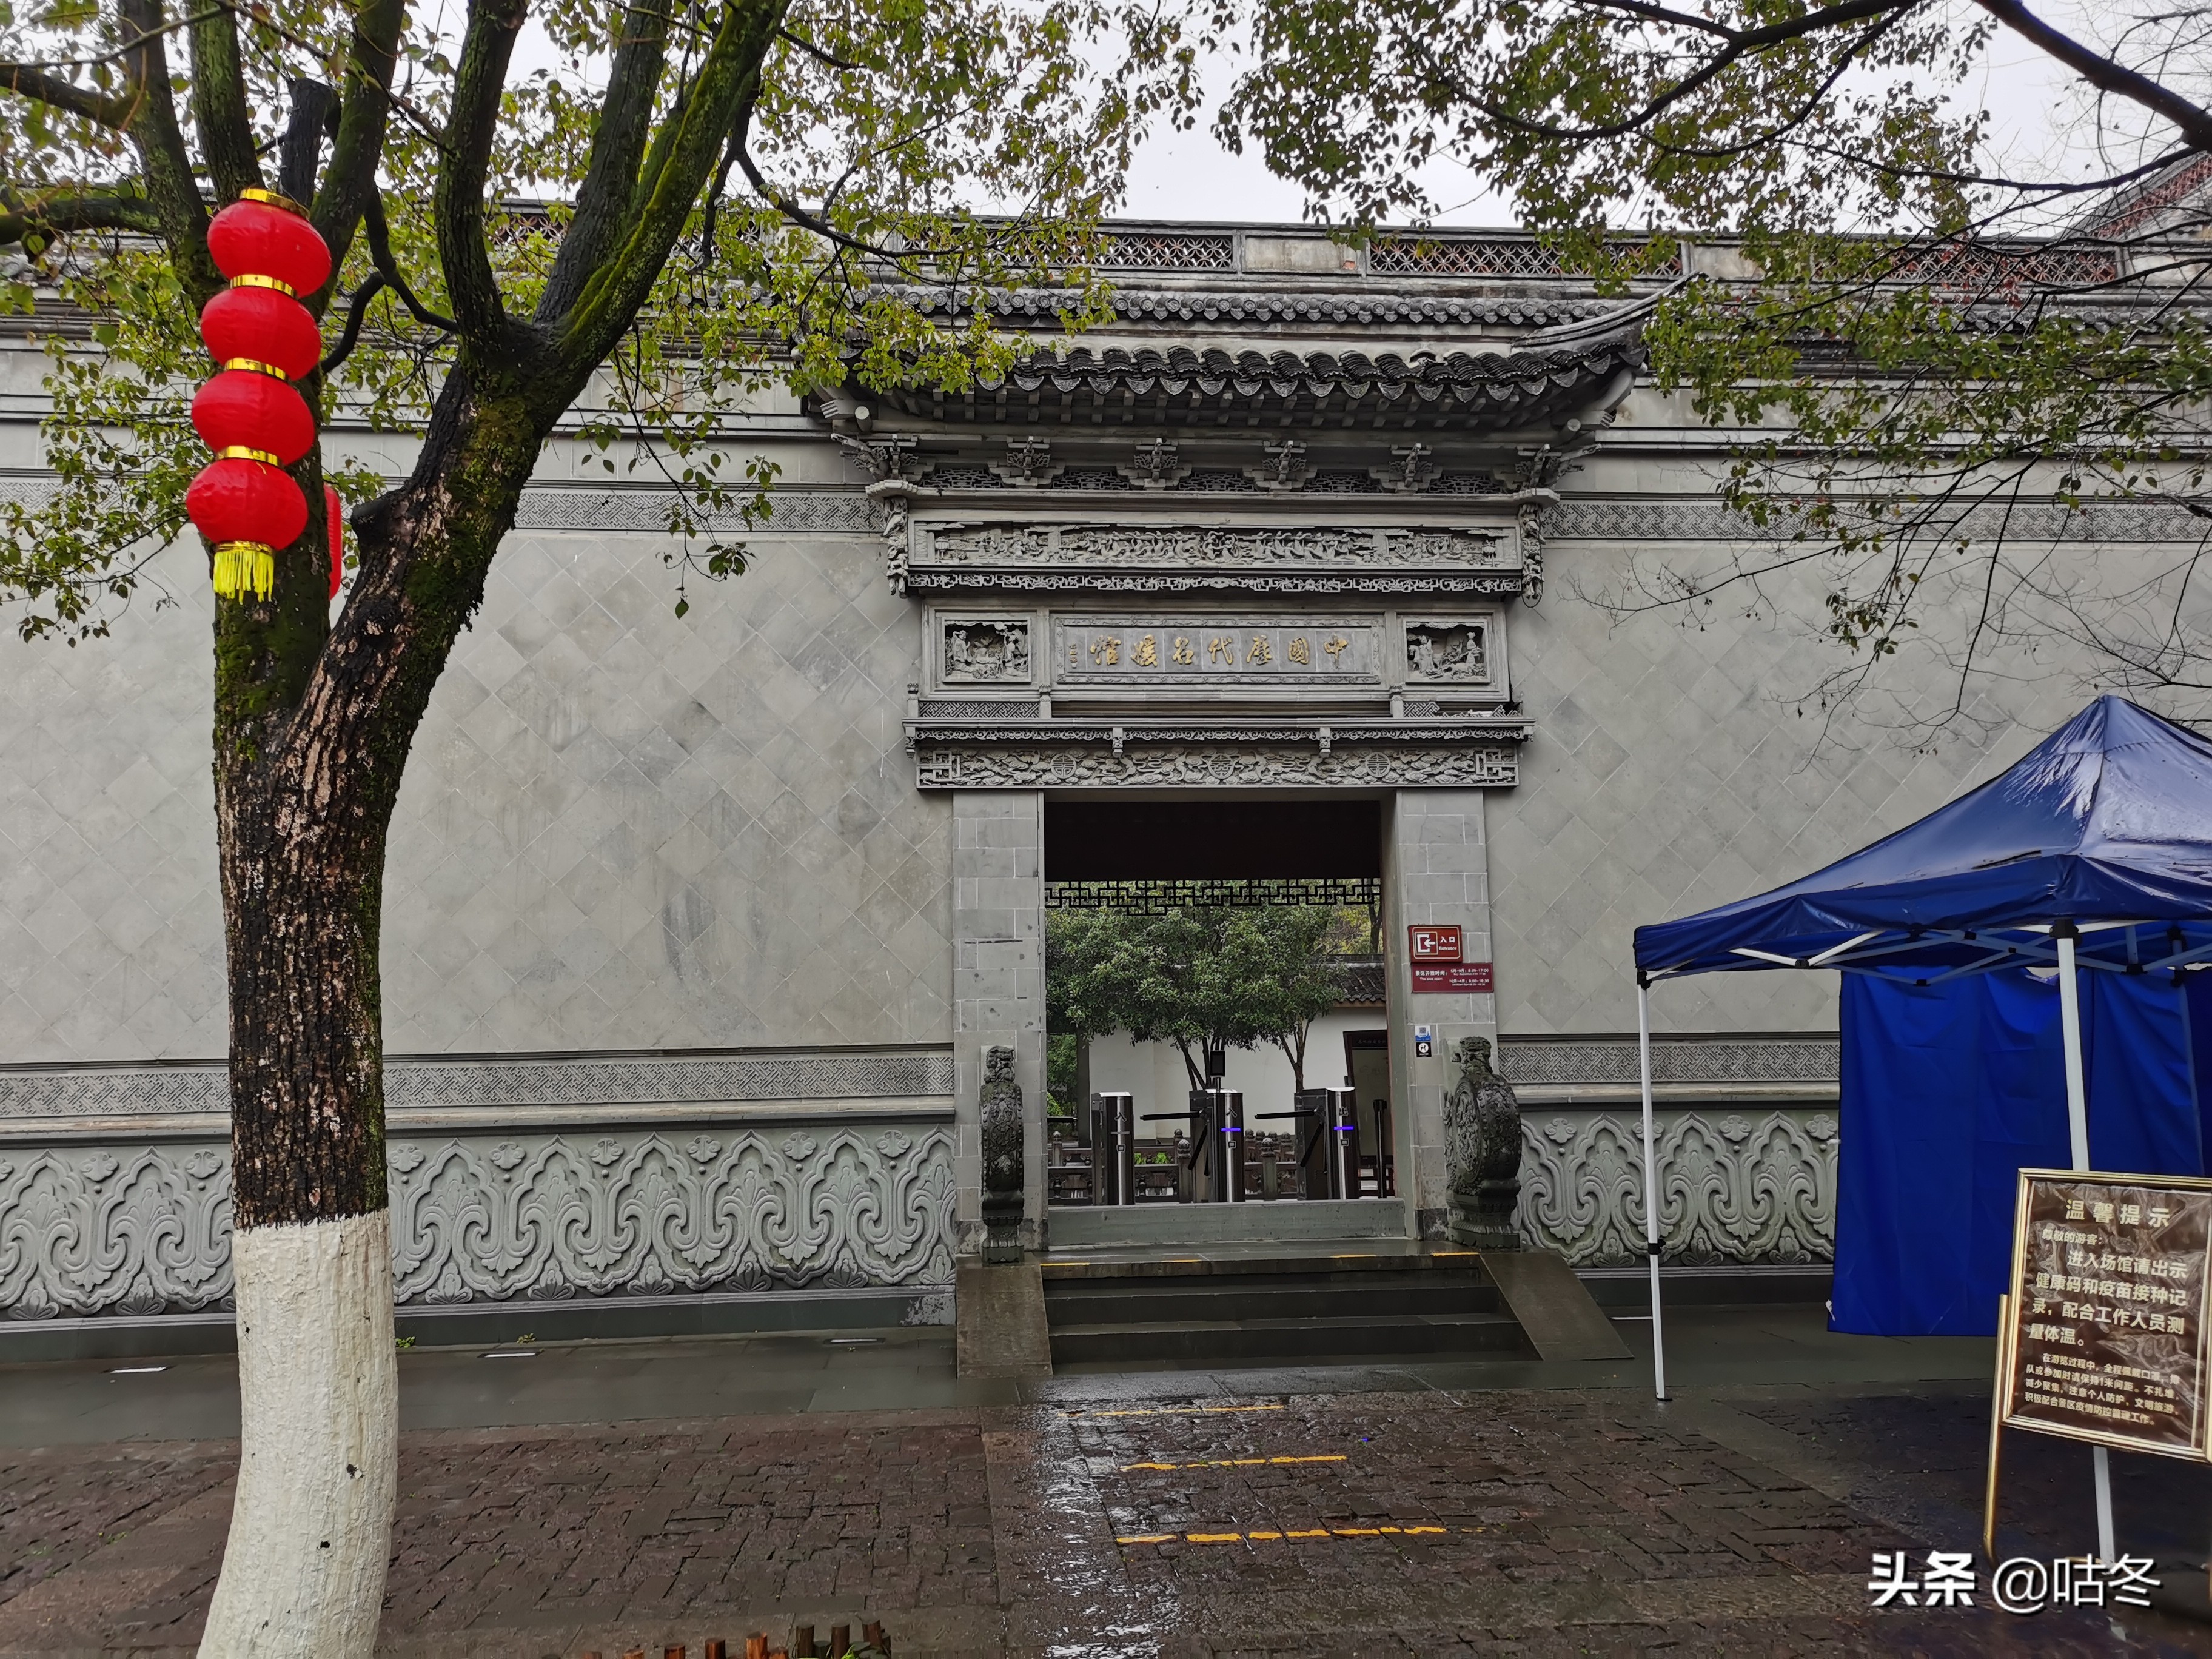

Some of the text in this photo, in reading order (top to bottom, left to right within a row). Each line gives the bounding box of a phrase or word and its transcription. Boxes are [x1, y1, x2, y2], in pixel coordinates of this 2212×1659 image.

[1114, 1111, 1127, 1152] 入口
[1225, 1107, 1238, 1149] 入口
[1339, 1106, 1350, 1147] 出口
[2065, 1199, 2170, 1228] 温馨提示
[2067, 1250, 2188, 1279] 进入场馆请出示
[2036, 1272, 2187, 1306] 健康码和疫苗接种记
[2028, 1322, 2084, 1346] 量体温。
[2032, 1297, 2185, 1335] 录，配合工作人员测
